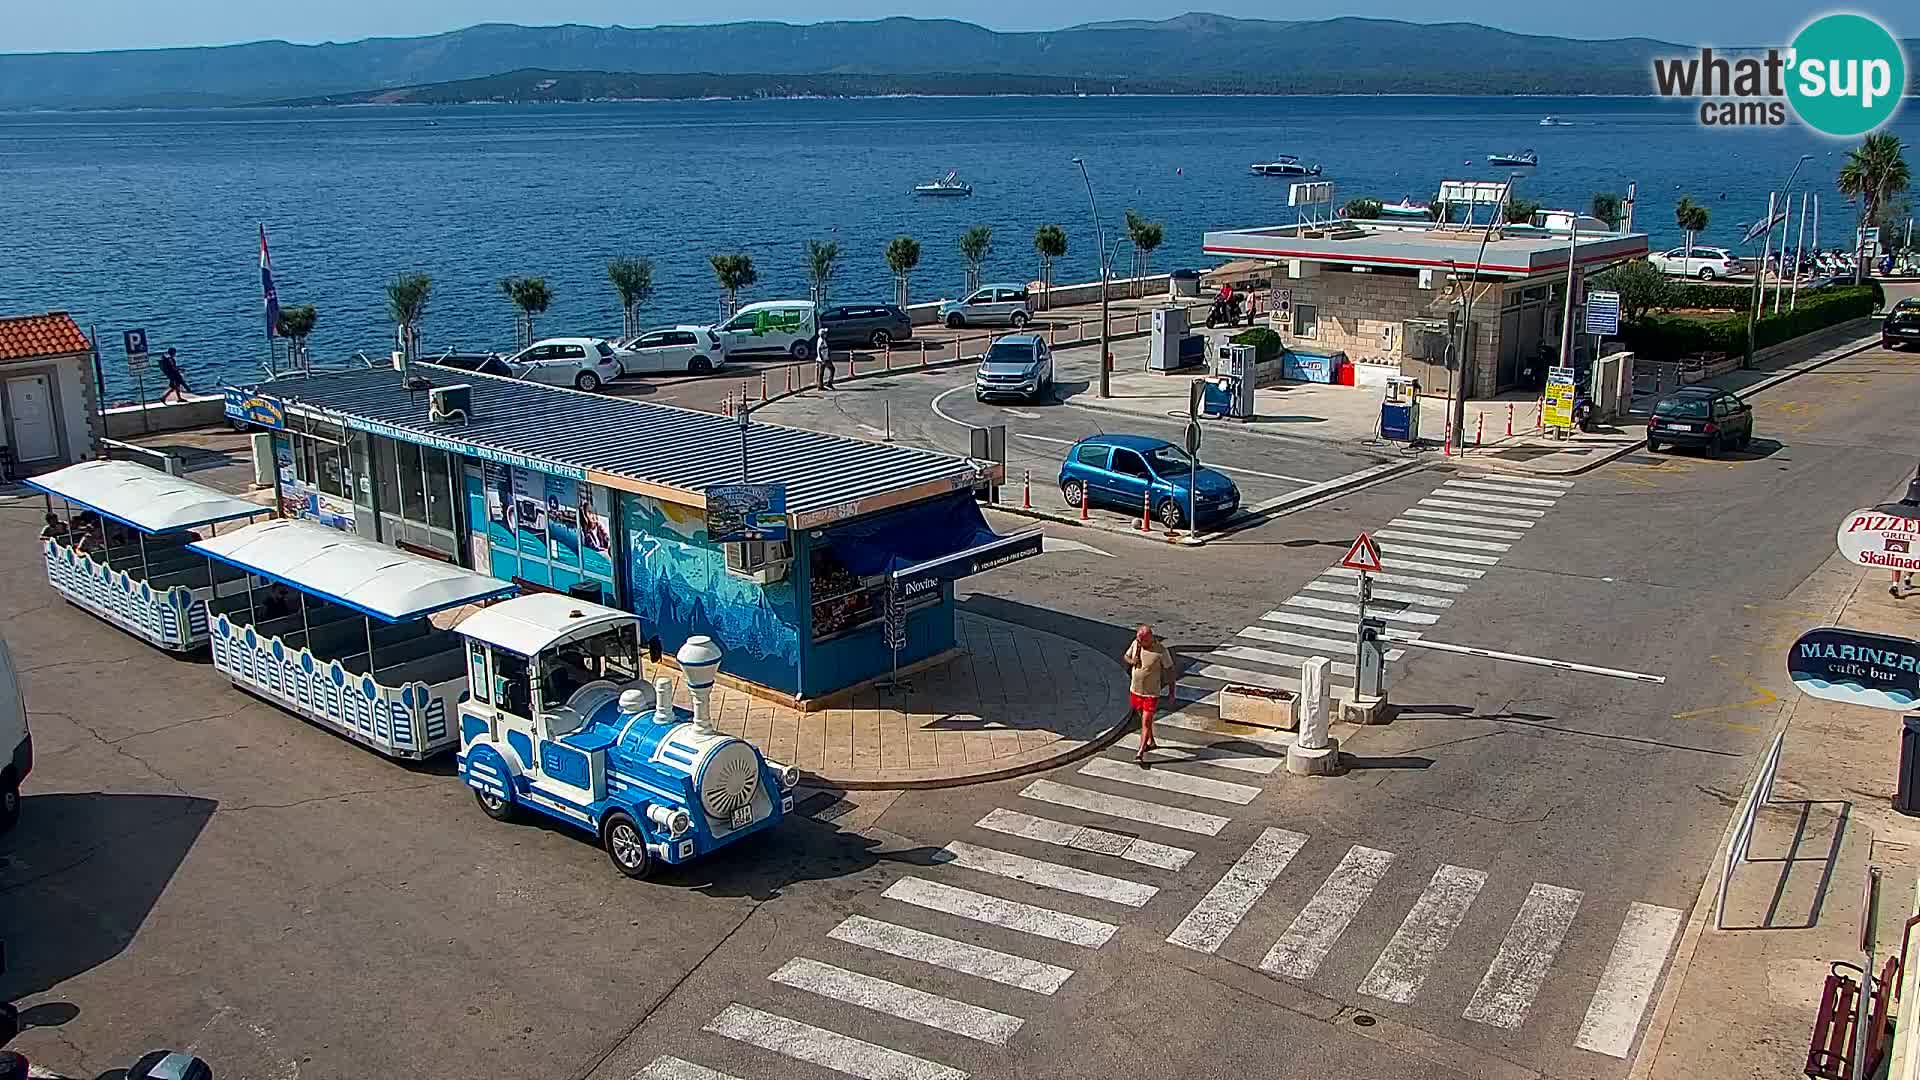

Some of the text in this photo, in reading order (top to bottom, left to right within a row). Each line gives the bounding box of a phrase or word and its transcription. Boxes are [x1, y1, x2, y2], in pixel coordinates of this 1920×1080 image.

[130, 333, 141, 351] P
[477, 448, 582, 479] BUS STATION TICKET OFFICE
[1881, 532, 1917, 542] GRILL
[1828, 663, 1897, 681] caffe bar
